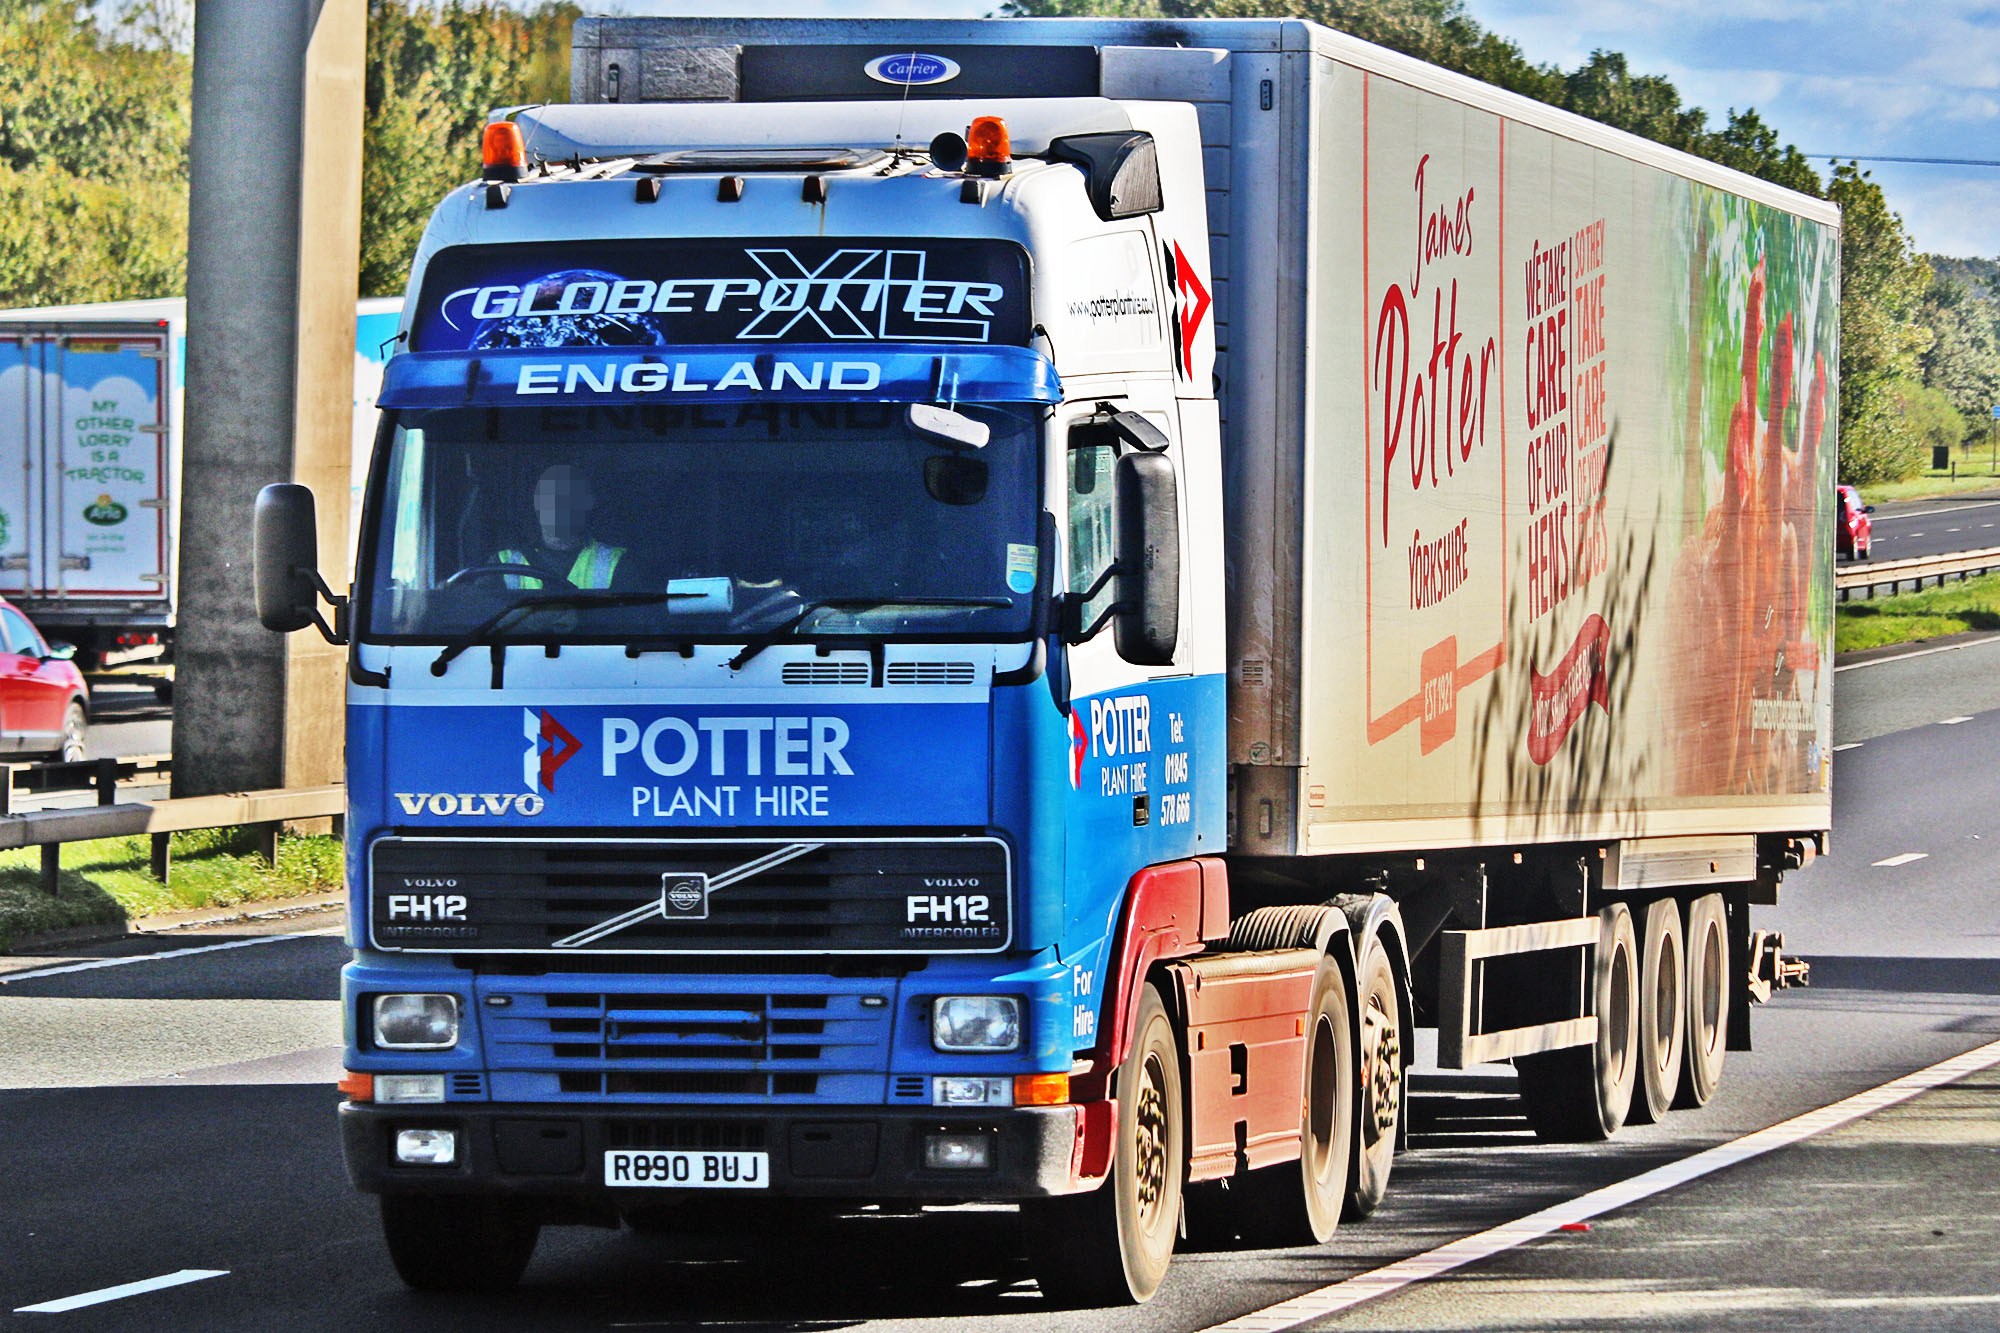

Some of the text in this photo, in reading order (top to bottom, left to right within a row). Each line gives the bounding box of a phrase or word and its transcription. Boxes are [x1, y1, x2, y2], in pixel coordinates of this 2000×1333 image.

[887, 62, 938, 74] Carrier
[1410, 153, 1474, 299] James
[1575, 218, 1605, 279] SO THEY
[736, 249, 989, 341] XL
[1525, 239, 1566, 321] WE TAKE
[468, 278, 1004, 319] GLOBEPOTTER
[1575, 273, 1605, 365] TAKE
[516, 361, 882, 395] ENGLAND
[1525, 308, 1567, 431] CARE
[92, 400, 118, 413] MY
[1374, 277, 1496, 549] Potter
[1576, 360, 1606, 451] CARE
[75, 417, 135, 432] OTHER
[78, 434, 133, 448] LORRY
[91, 450, 119, 463] IS A
[1528, 421, 1568, 516] OF OUR
[65, 467, 146, 484] TRACTOR
[1577, 444, 1607, 506] OF YOUR
[1578, 494, 1608, 588] EGGS
[1408, 516, 1468, 611] YORKSHIRE
[1528, 501, 1569, 624] HENS
[1424, 671, 1453, 723] EST 1921
[1090, 694, 1151, 758] POTTER
[602, 716, 855, 777] POTTER
[1101, 762, 1147, 797] PLANT HIRE
[1165, 752, 1188, 785] 01845
[394, 792, 545, 816] VOLVO
[632, 786, 829, 817] PLANT HIRE
[1160, 794, 1175, 827] 578
[404, 878, 457, 887] VOLVO
[924, 878, 980, 887] VOLVO
[388, 895, 467, 921] FH12
[907, 895, 989, 922] FH12
[383, 926, 478, 937] INTERCOOLER
[901, 927, 1000, 938] INTERCOOLER
[1073, 964, 1093, 997] For
[1073, 1003, 1094, 1037] Hire
[614, 1154, 759, 1183] R890 BUJ
